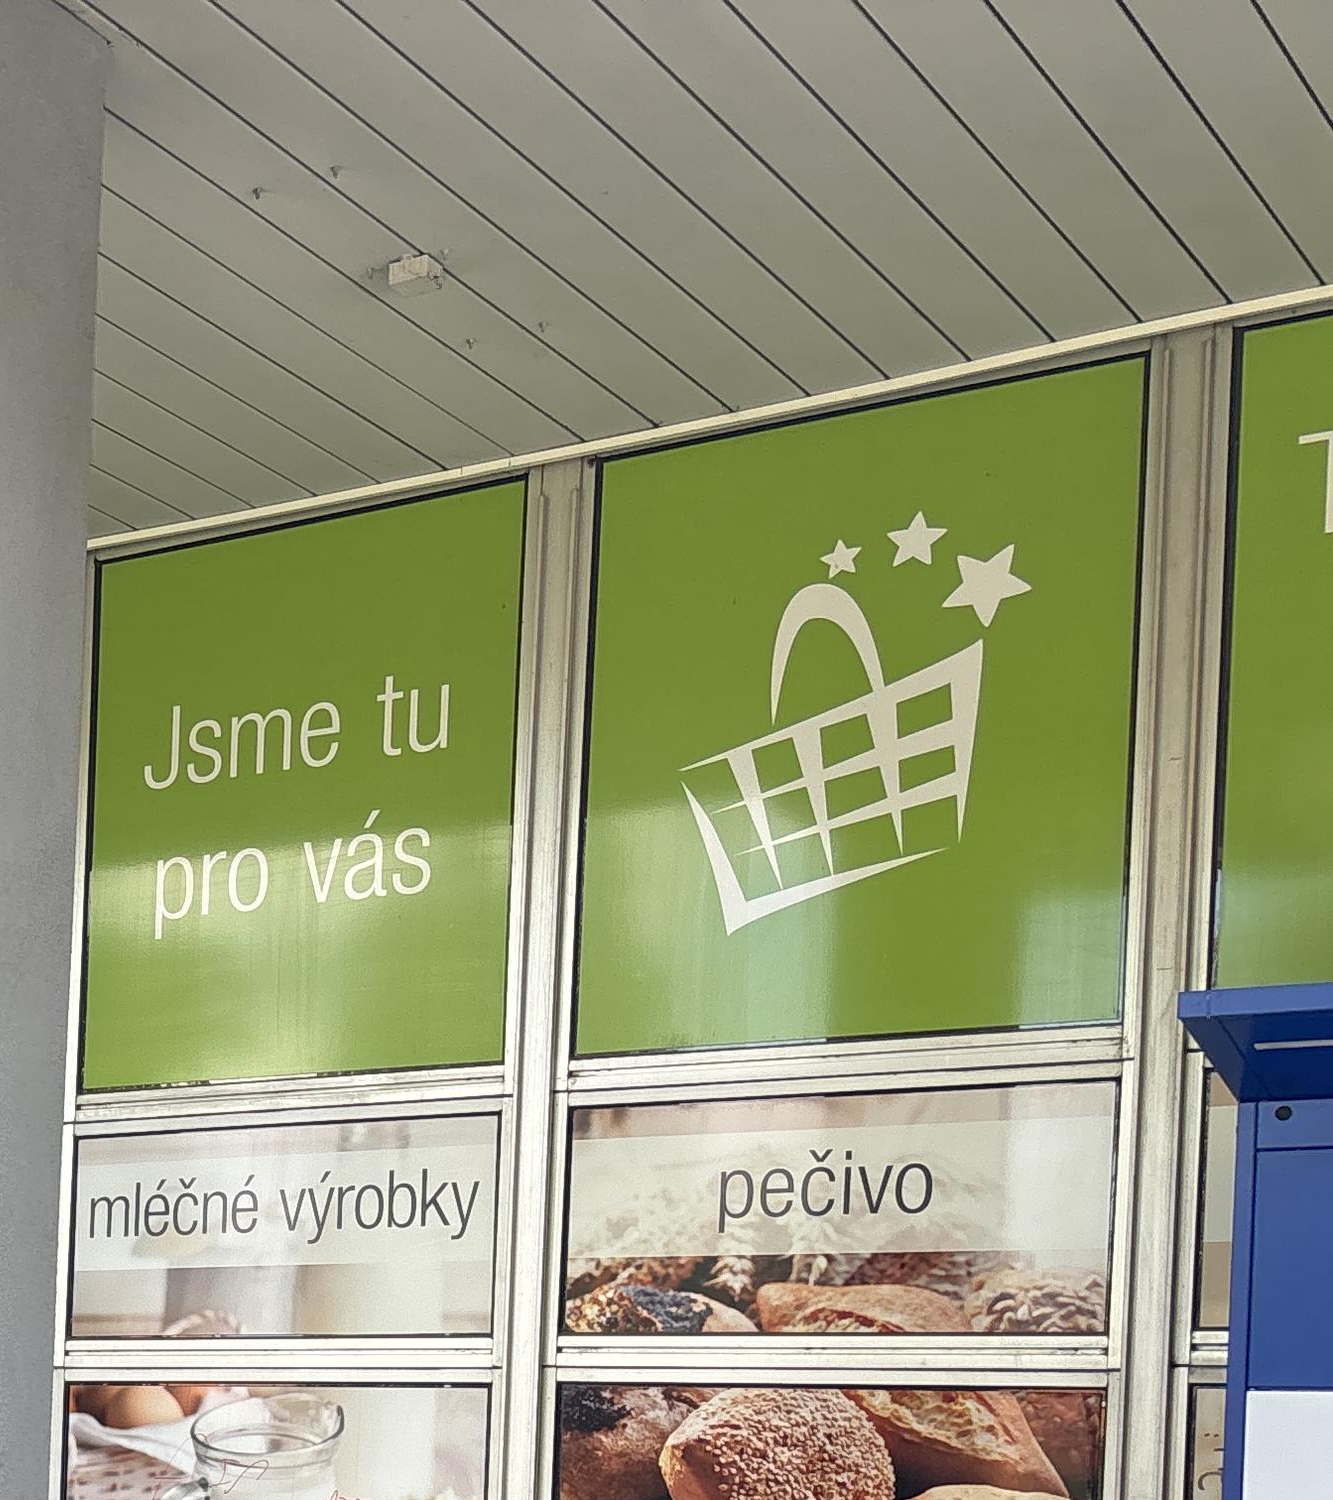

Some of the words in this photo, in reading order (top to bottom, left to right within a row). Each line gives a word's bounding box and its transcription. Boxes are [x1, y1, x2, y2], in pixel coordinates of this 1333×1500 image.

[143, 700, 341, 791] Jsme
[376, 675, 451, 757] tu
[153, 845, 269, 940] pro
[303, 809, 432, 904] vás
[88, 1174, 259, 1240] mléčné
[278, 1168, 481, 1246] výrobky
[717, 1149, 934, 1234] pečivo
